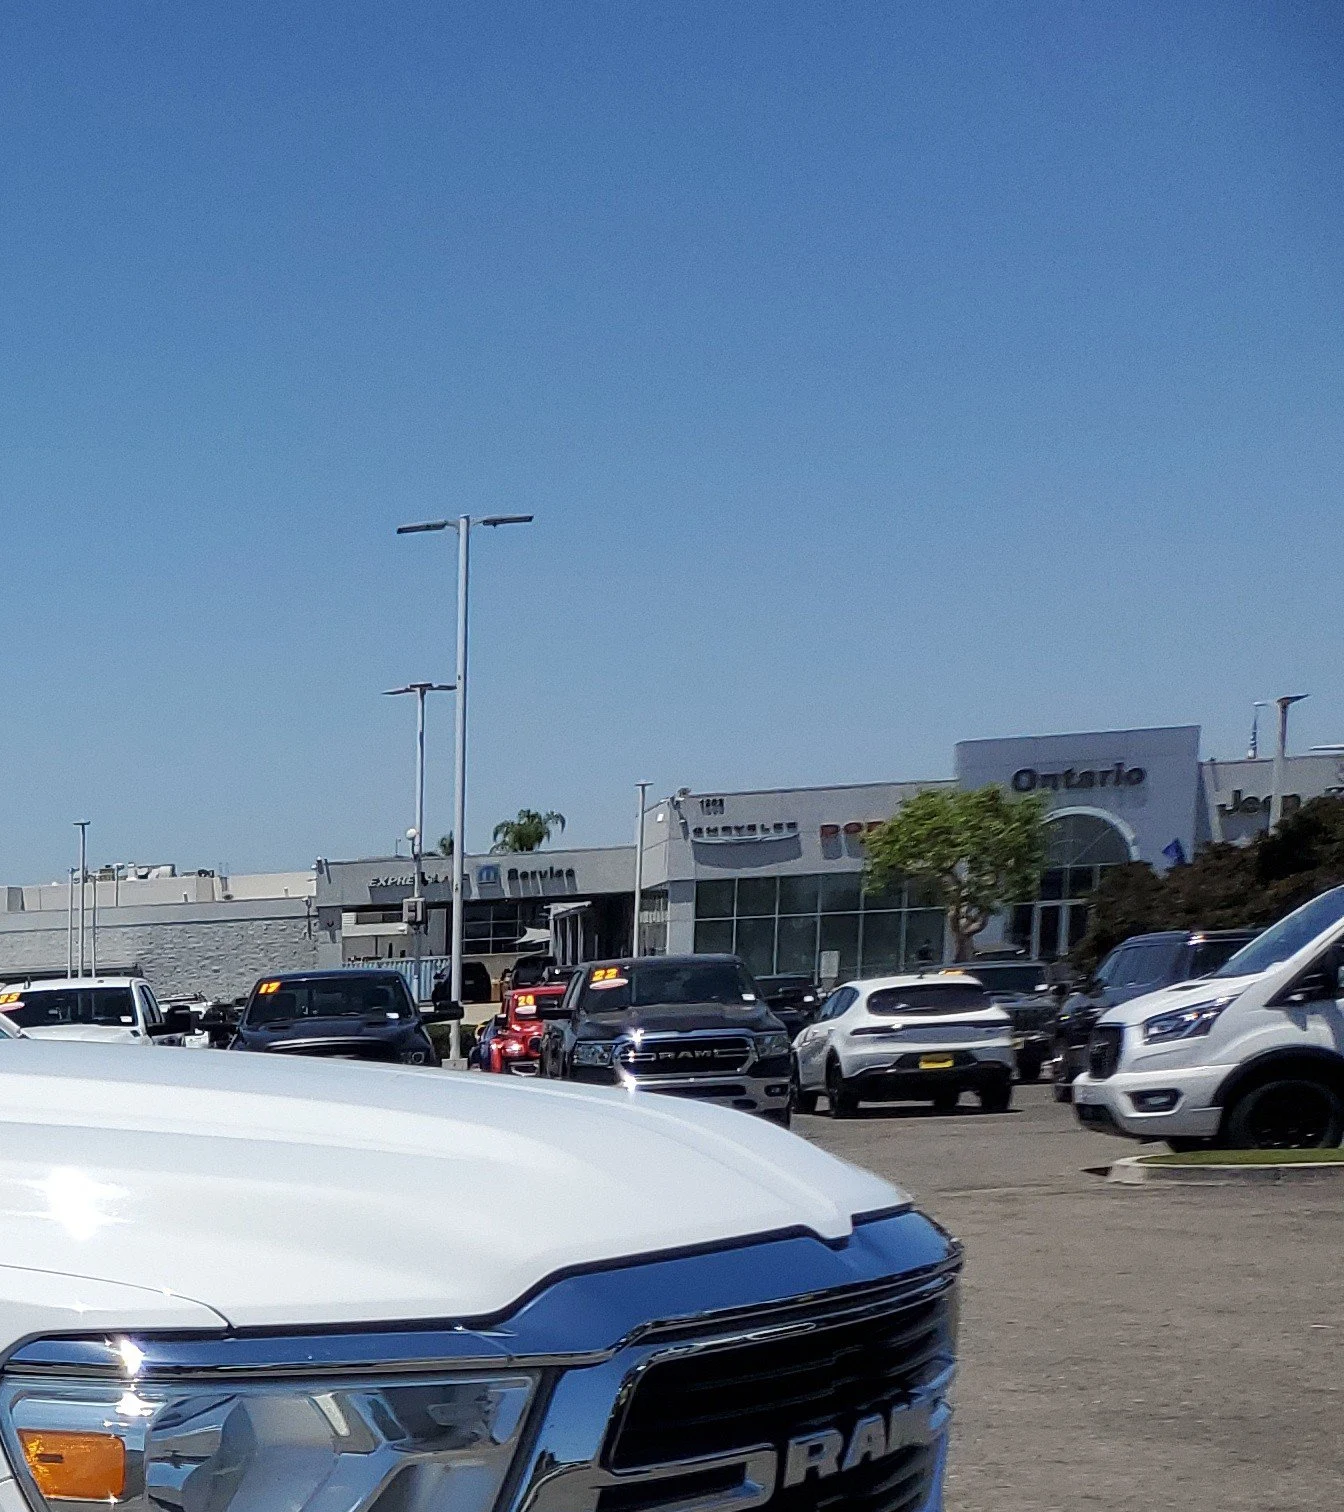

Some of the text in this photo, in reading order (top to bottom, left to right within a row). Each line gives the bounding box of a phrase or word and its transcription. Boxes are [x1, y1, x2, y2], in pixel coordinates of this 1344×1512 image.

[1012, 762, 1147, 792] Ontario
[592, 968, 618, 981] 22
[659, 1049, 713, 1060] RAM
[782, 1402, 937, 1489] RAM
